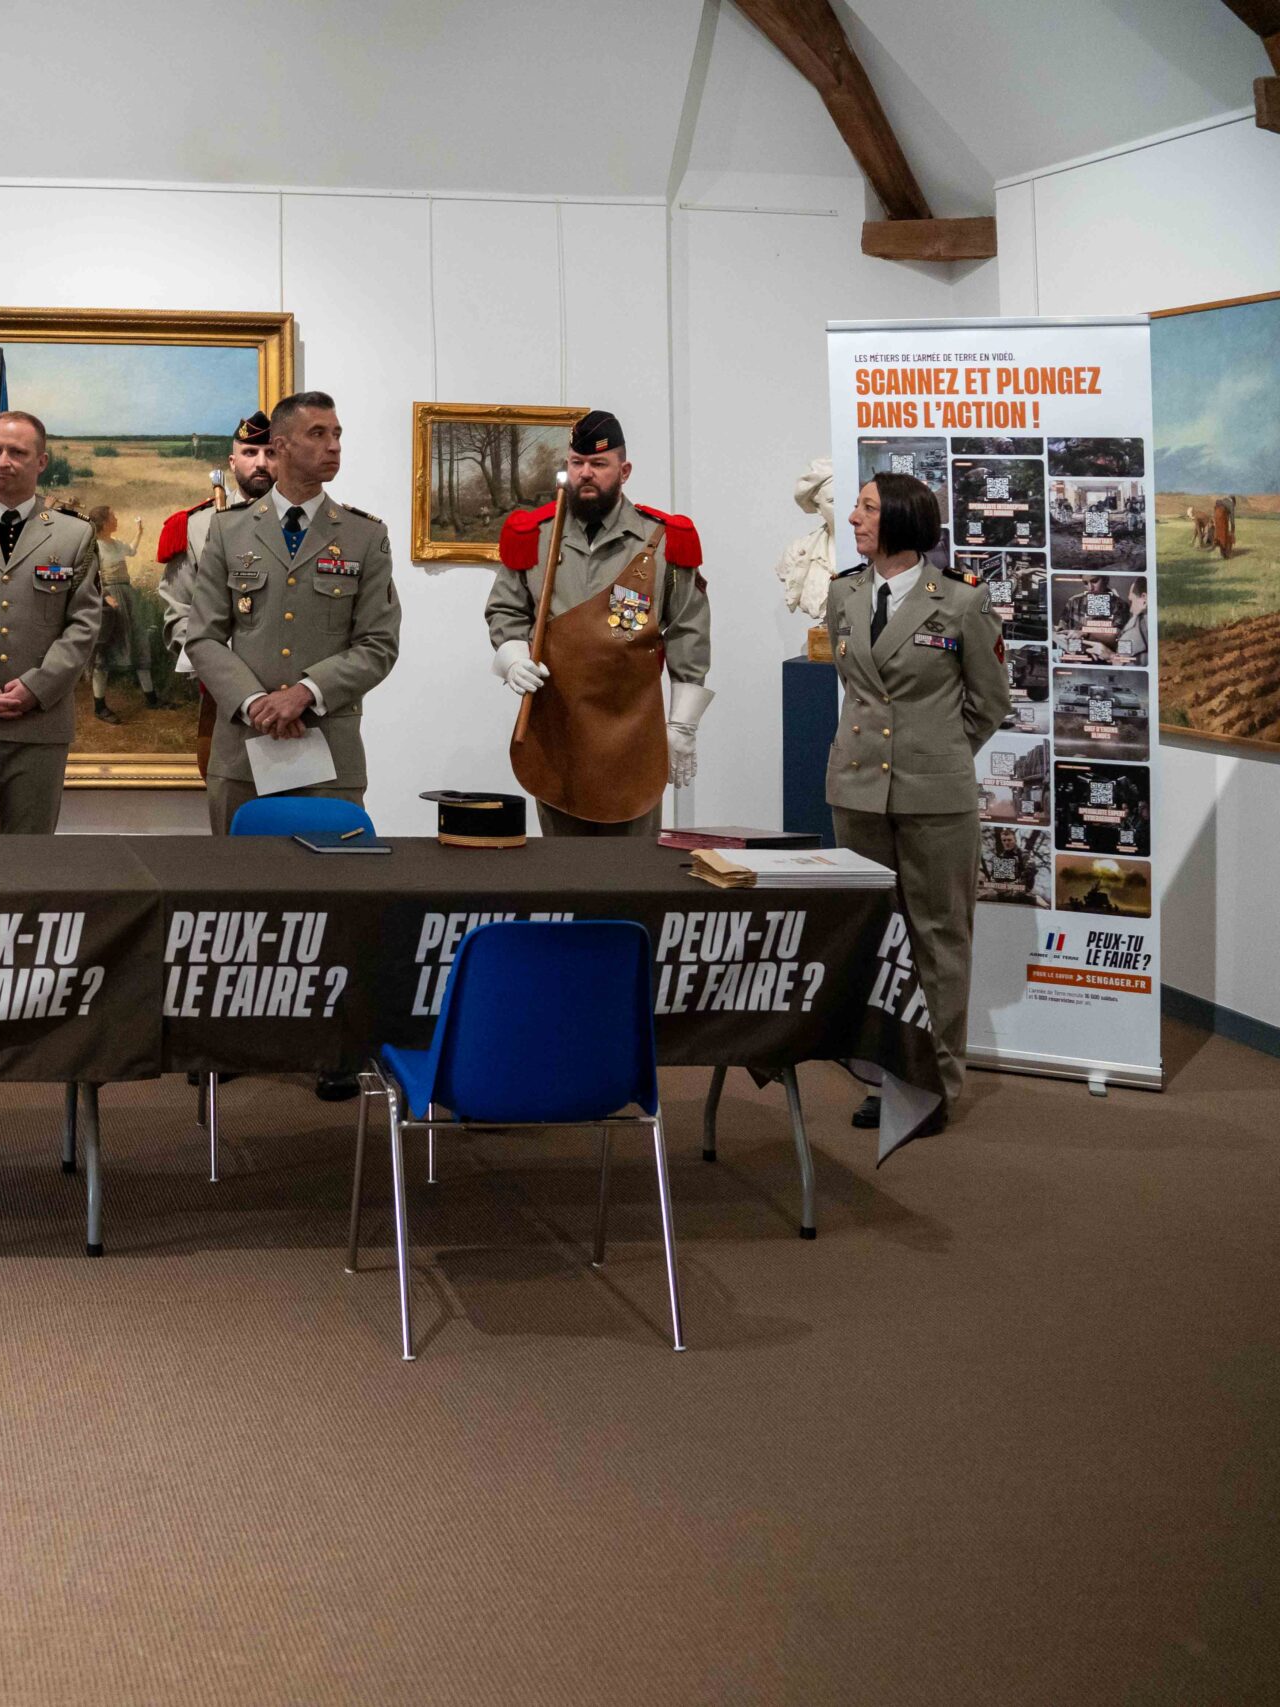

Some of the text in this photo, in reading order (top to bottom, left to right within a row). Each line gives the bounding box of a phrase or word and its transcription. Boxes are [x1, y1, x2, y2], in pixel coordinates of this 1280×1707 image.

[855, 354, 868, 363] LES
[902, 354, 911, 362] DE
[943, 354, 952, 362] DE
[954, 354, 978, 362] TERRE
[980, 353, 990, 361] EN
[856, 367, 1102, 395] SCANNEZ ET PLONGEZ
[857, 401, 918, 428] DANS
[924, 401, 1027, 428] L'ACTION
[165, 912, 327, 963] PEUX-TU
[656, 911, 806, 961] PEUX-TU
[1086, 931, 1144, 952] PEUX-TU
[1086, 949, 1102, 966] LE
[1103, 950, 1141, 970] FAIRE
[165, 966, 207, 1016] LE
[210, 966, 320, 1017] FAIRE
[654, 964, 698, 1014] LE
[696, 962, 798, 1011] FAIRE
[868, 962, 911, 1014] LE
[1086, 974, 1146, 989] SENGAGER.FR
